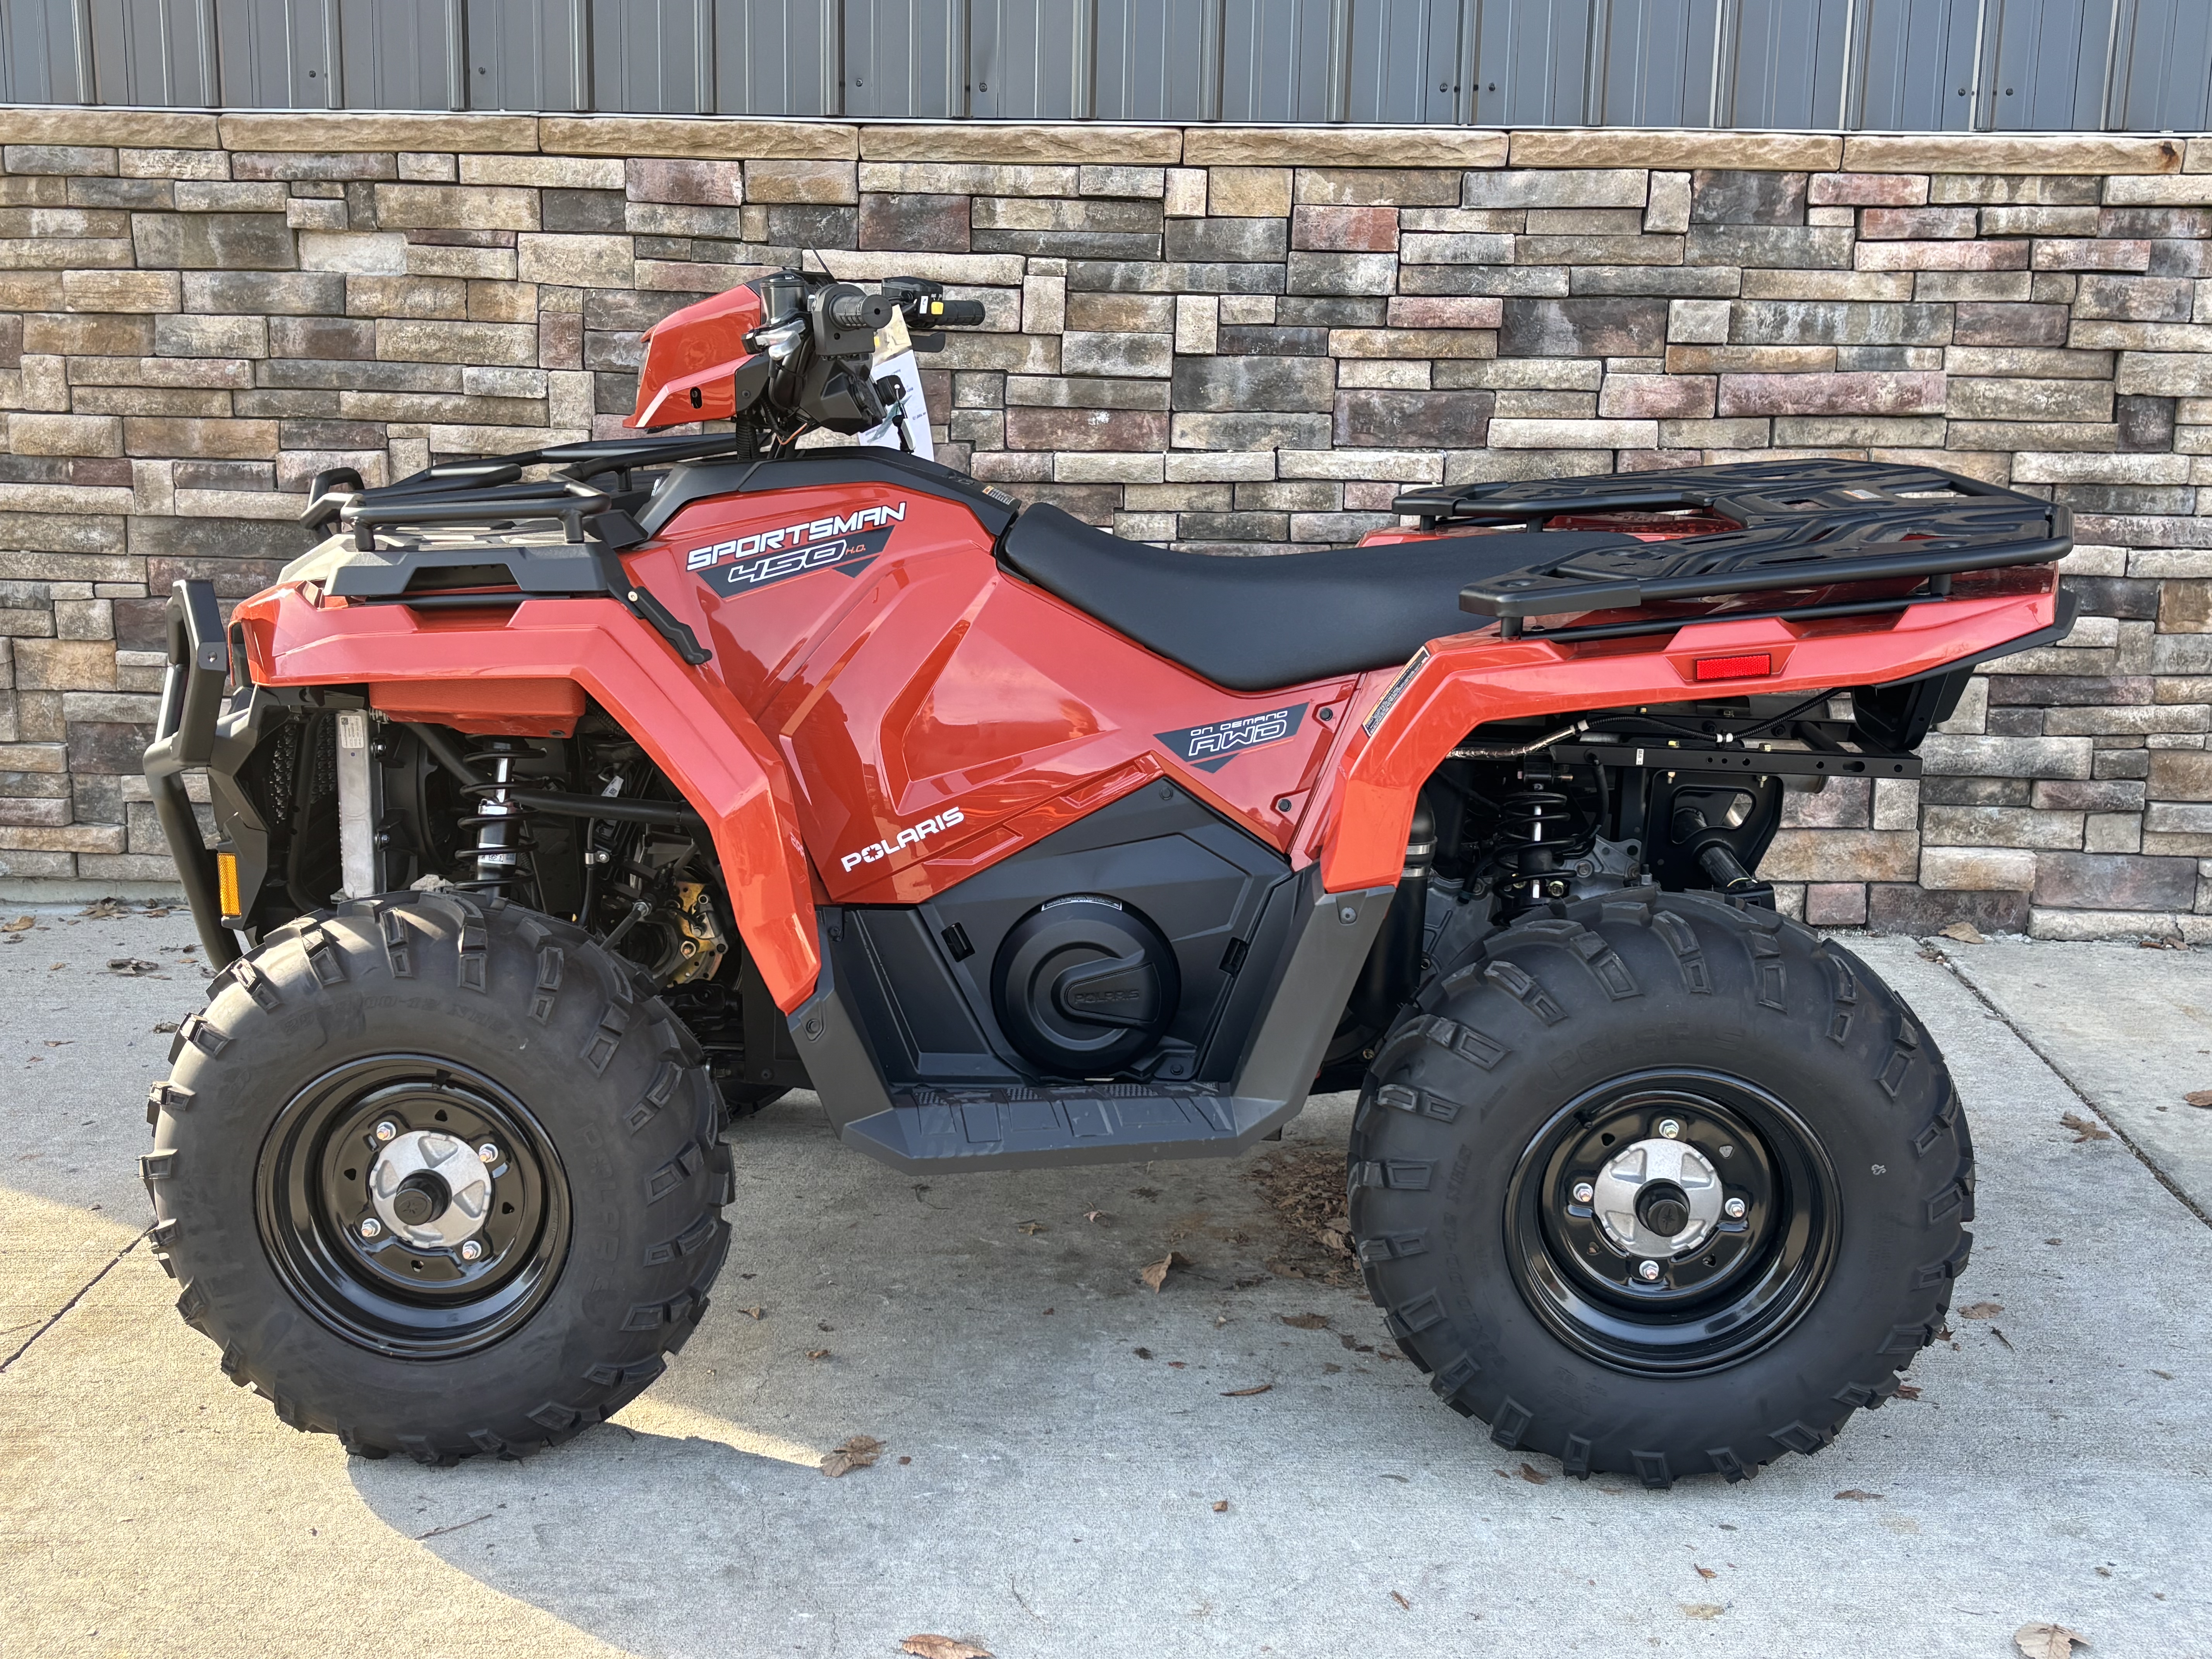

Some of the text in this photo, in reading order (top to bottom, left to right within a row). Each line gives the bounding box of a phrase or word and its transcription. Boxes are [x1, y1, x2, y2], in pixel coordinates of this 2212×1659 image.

[687, 502, 907, 571] SPORTSMAN
[727, 539, 866, 583] 450 H.O.
[1188, 719, 1287, 757] AWD
[1190, 710, 1288, 737] ON DEMAND
[840, 806, 965, 873] POLARIS
[1074, 989, 1139, 1004] POLARIS
